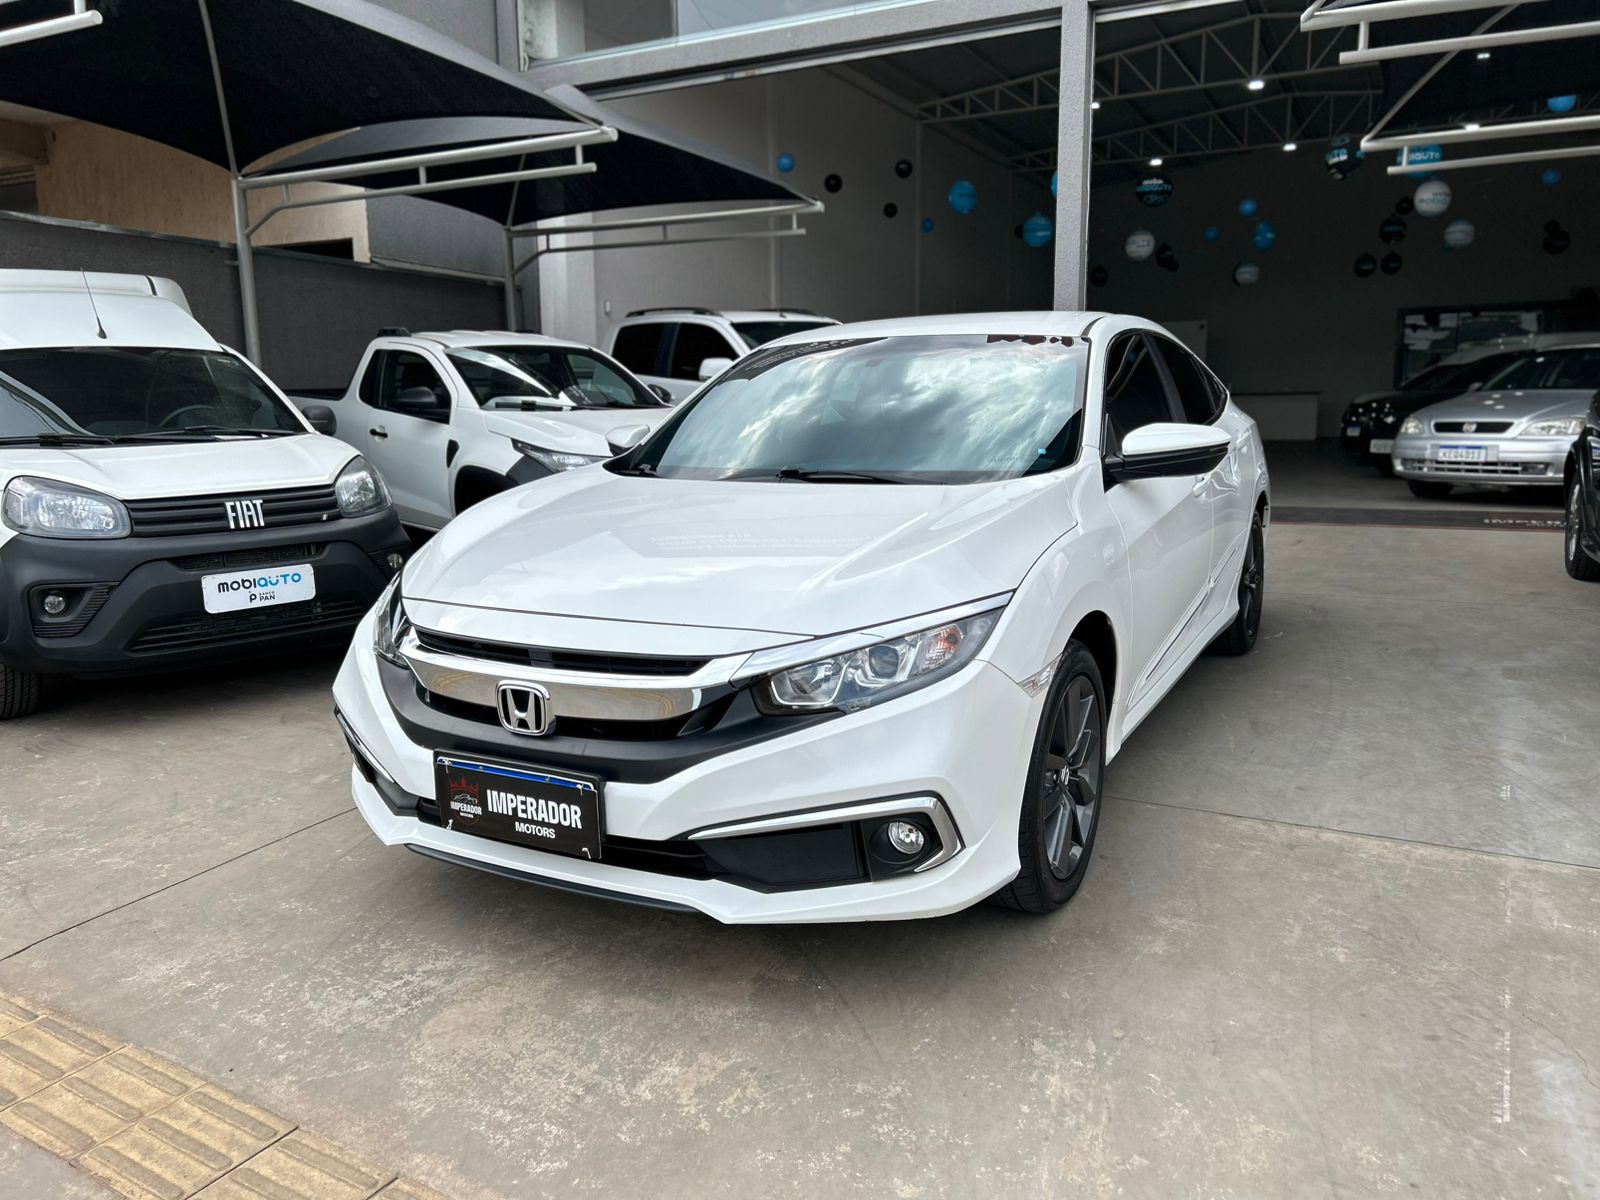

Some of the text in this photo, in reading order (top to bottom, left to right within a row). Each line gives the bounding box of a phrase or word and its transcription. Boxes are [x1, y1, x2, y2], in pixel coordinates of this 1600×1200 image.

[224, 499, 265, 529] FIAT
[450, 801, 482, 815] IMPERADOR
[486, 789, 583, 829] IMPERADOR
[515, 821, 556, 839] MOTORS
